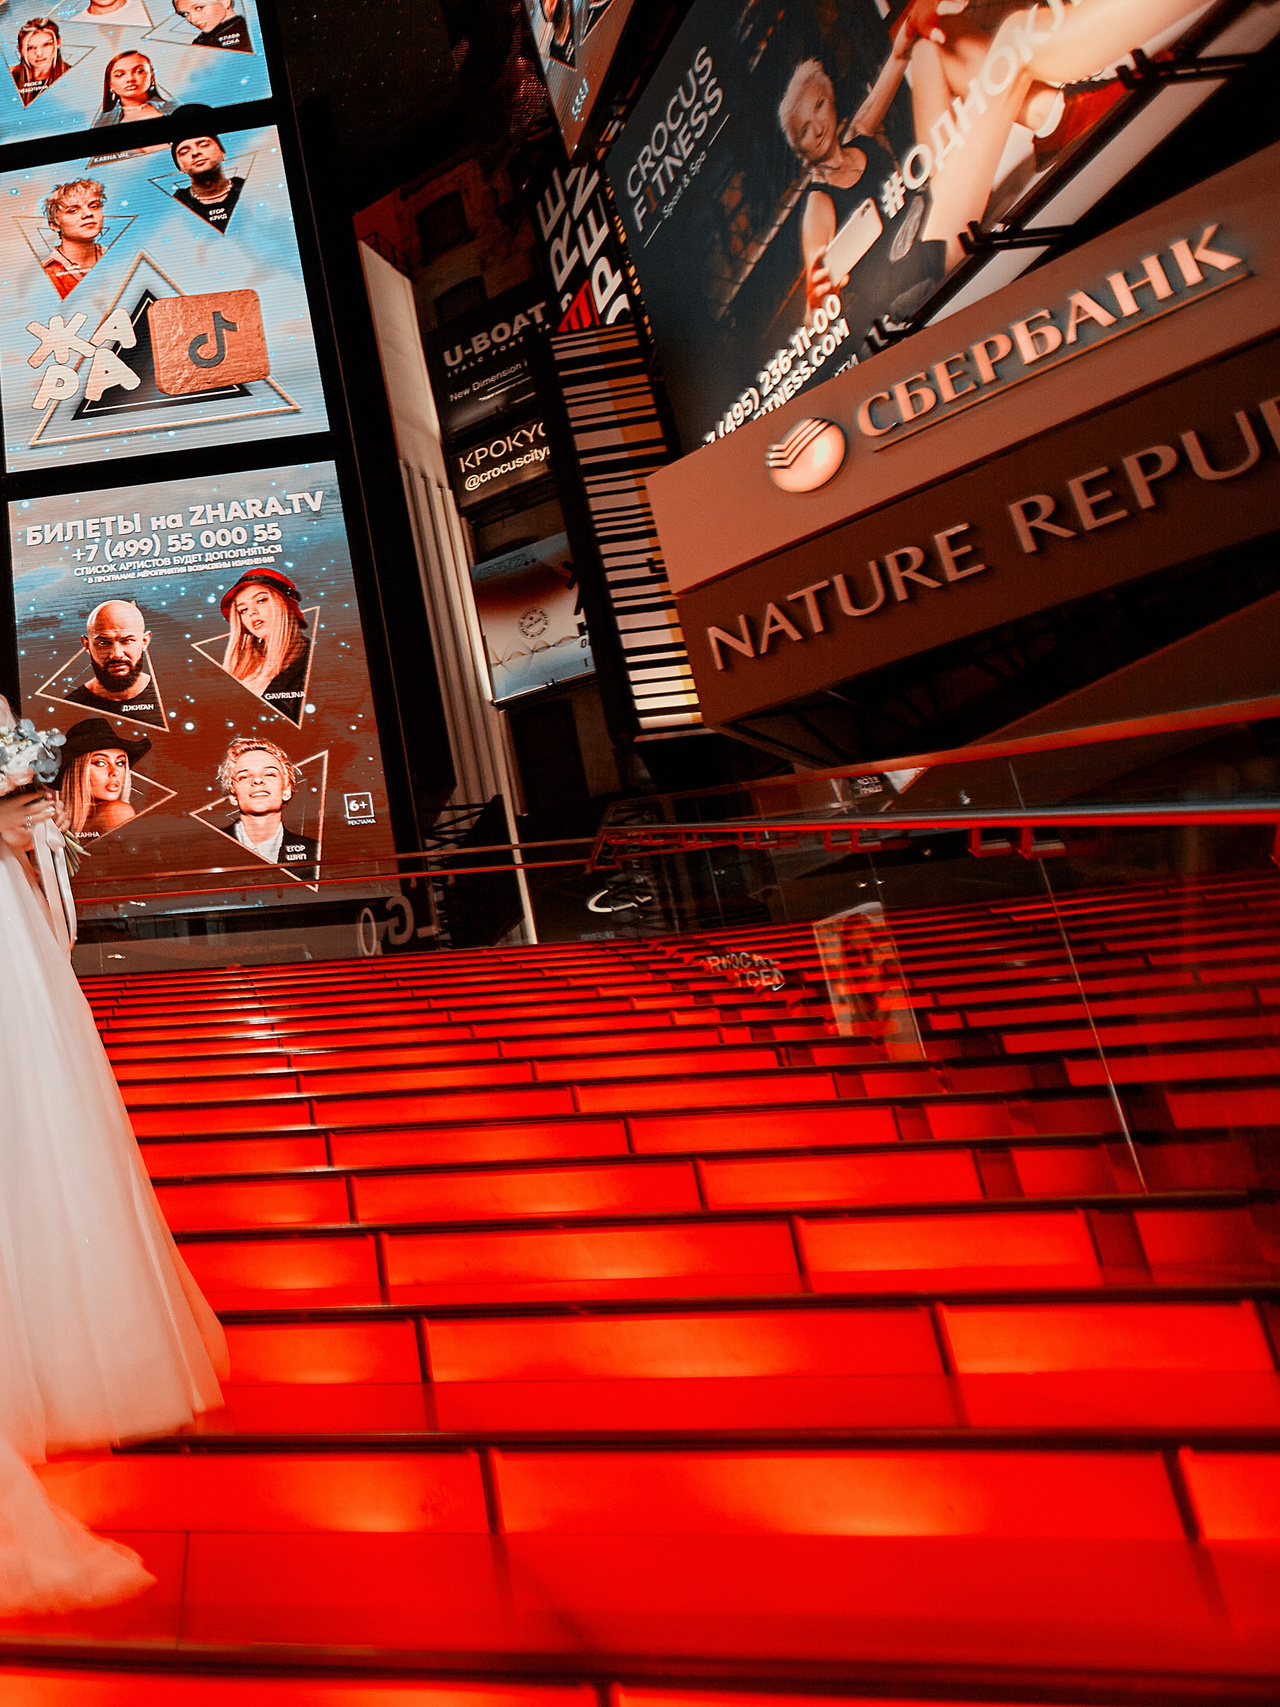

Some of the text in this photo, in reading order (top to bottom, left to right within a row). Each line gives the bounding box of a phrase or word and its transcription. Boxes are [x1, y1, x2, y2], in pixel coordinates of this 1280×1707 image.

[627, 46, 713, 197] CROCUS
[443, 301, 547, 368] U-BOAT
[757, 293, 842, 397] 236-11-00
[857, 223, 1244, 437] СБЕРБАНК
[449, 387, 470, 402] New
[472, 363, 522, 391] Dimension
[26, 491, 324, 546] БИЛЕТЫ на ZHARA.TV
[71, 522, 282, 563] +7 (499) 55 000 55
[74, 544, 283, 577] СПИСОК АРТИСТОВ БУДЕТ ДОПОЛНЯТЬСЯ
[706, 522, 986, 671] NATURE
[122, 703, 154, 712] ДЖИГАН
[264, 691, 306, 700] GAVRILINA
[347, 817, 377, 826] РЕКЛАМА
[349, 799, 369, 812] 6+
[287, 844, 306, 853] ЕГОР
[287, 853, 307, 861] ШИП
